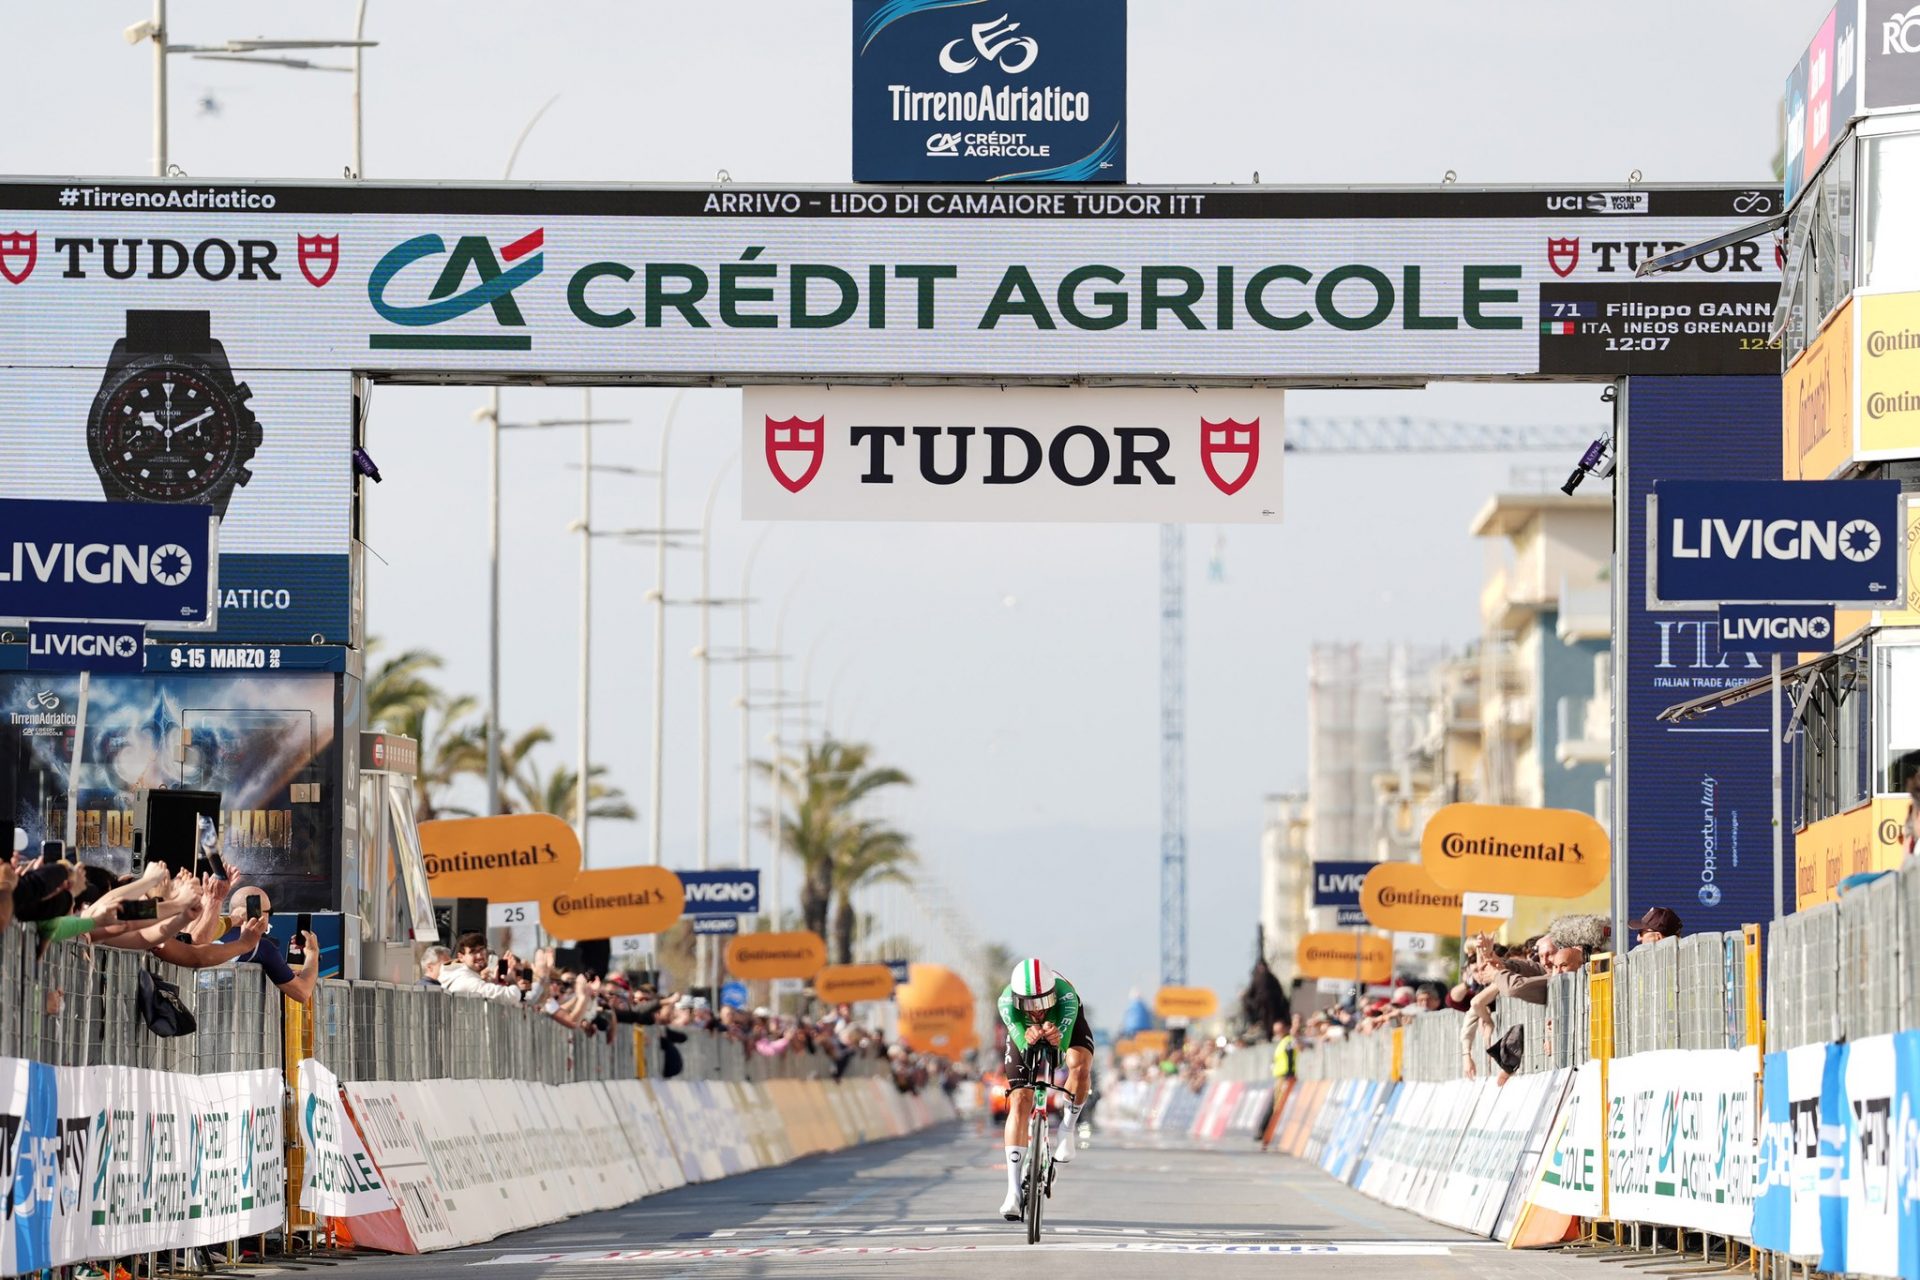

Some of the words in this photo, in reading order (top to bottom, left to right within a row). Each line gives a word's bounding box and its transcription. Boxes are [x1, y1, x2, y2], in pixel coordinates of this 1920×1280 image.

[888, 84, 1089, 121] TirrenoAdriatico
[964, 131, 1027, 144] CRÉDIT
[964, 145, 1050, 157] AGRICOLE
[59, 189, 276, 210] #TirrenoAdriatico
[703, 194, 800, 213] ARRIVO
[829, 194, 887, 214] LIDO
[896, 195, 919, 214] DI
[926, 195, 1065, 215] CAMAIORE
[1074, 195, 1160, 215] TUDOR
[1169, 195, 1206, 216] ITT
[1546, 196, 1583, 210] UCI
[54, 238, 281, 281] TUDOR
[567, 246, 957, 329] CRÉDIT
[977, 264, 1524, 331] AGRICOLE
[1550, 303, 1581, 317] 71
[1606, 302, 1694, 319] Filippo
[1699, 303, 1777, 317] GANN
[1582, 322, 1612, 333] ITA
[1623, 322, 1680, 334] INEOS
[1605, 338, 1671, 351] 12:07
[850, 425, 1176, 486] TUDOR
[1672, 518, 1881, 562] LIVIGNO
[1723, 616, 1831, 640] LIVIGNO
[30, 633, 138, 658] LIVIGNO
[269, 649, 280, 658] 20
[171, 648, 206, 668] 9-15
[211, 648, 265, 669] MARZO
[269, 659, 280, 668] 26
[1654, 678, 1690, 688] ITALIAN
[1693, 678, 1723, 688] TRADE
[10, 712, 77, 725] TirrenoAdriatico
[1701, 773, 1719, 882] OpportunItaly
[1441, 833, 1564, 862] Continental
[685, 882, 756, 902] IVIGNO
[1378, 887, 1463, 907] Continent
[552, 888, 650, 918] Continental
[1478, 900, 1500, 913] 25
[504, 907, 525, 923] 25
